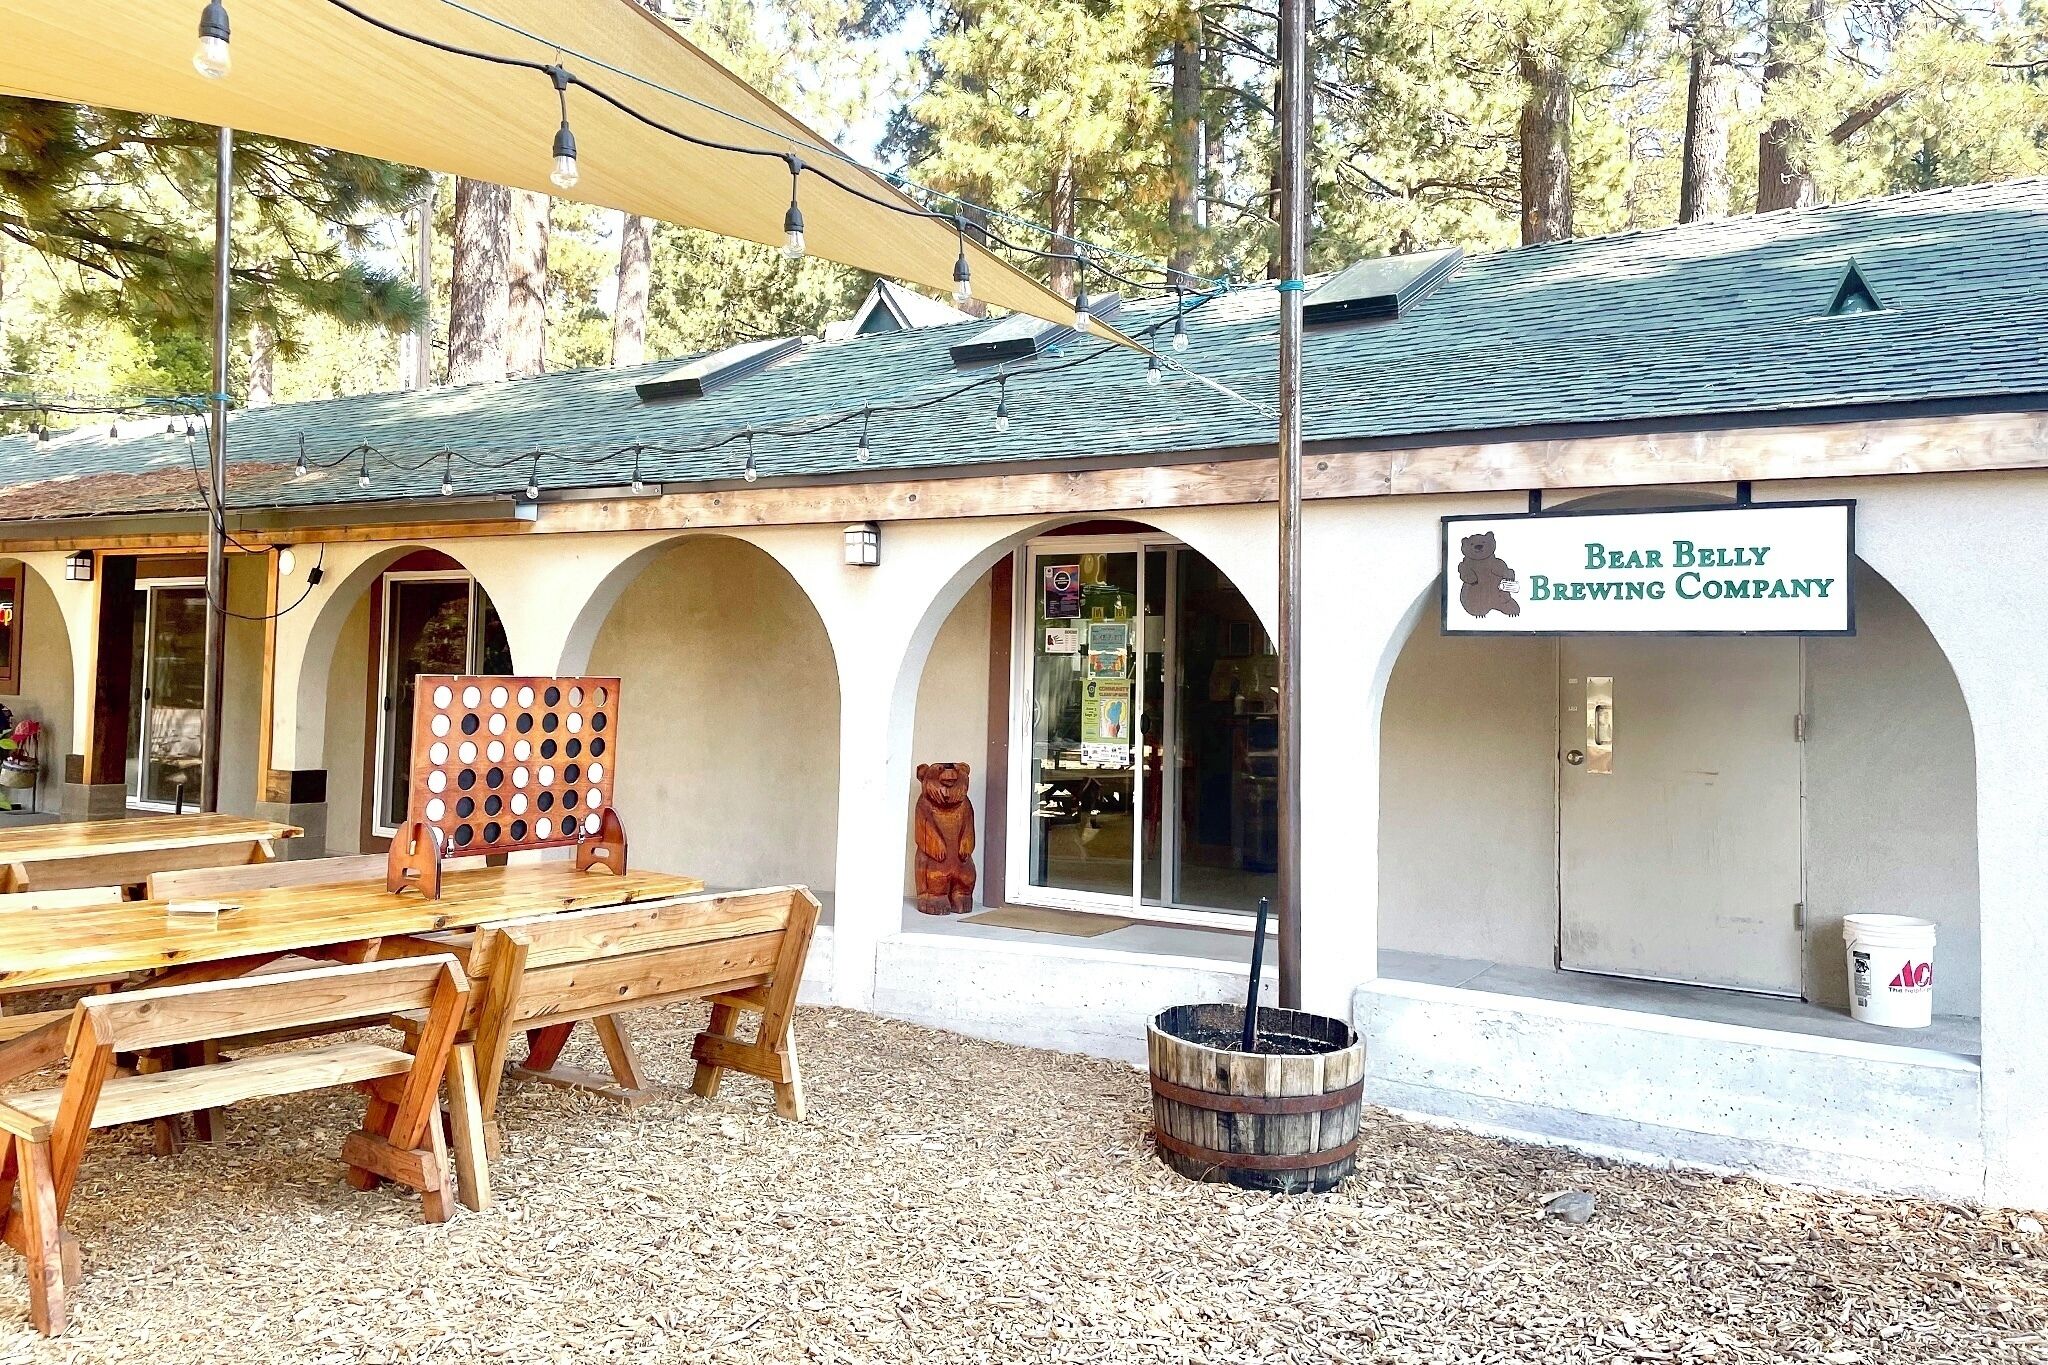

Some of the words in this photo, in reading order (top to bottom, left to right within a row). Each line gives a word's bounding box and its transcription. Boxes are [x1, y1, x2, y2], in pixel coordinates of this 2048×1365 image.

[1584, 543, 1664, 570] BEAR
[1672, 540, 1771, 568] BELLY
[1529, 575, 1666, 601] BREWING
[1675, 571, 1835, 600] COMPANY
